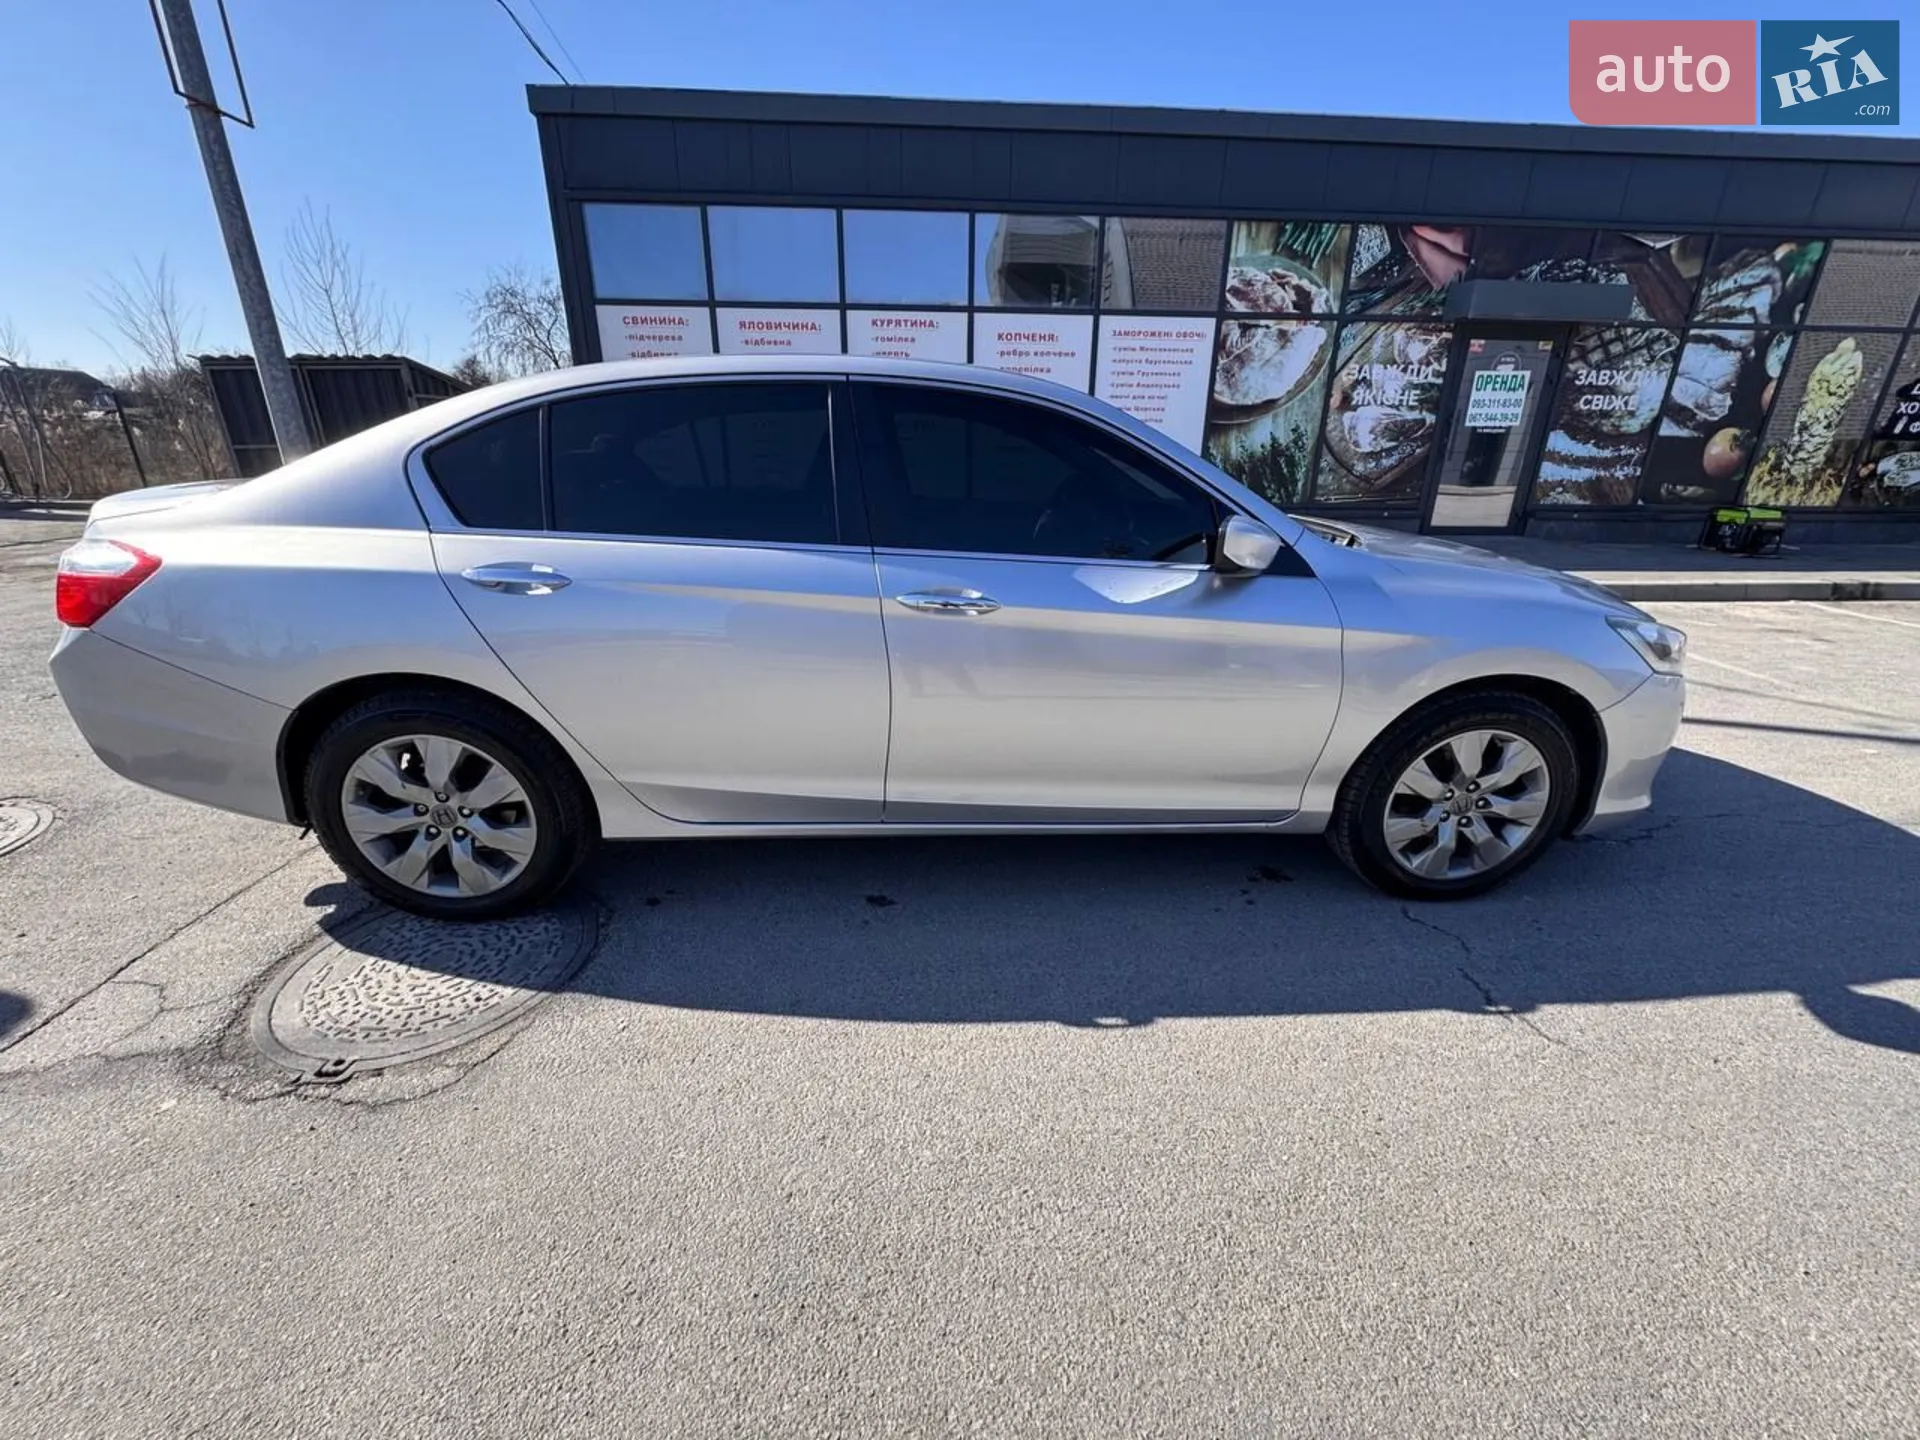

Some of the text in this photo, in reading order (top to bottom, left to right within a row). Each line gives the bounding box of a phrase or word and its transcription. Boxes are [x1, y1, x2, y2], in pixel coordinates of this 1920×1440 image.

[622, 315, 689, 326] СВИНИНА:
[738, 320, 822, 332] ЯЛОВИЧИНА:
[870, 318, 939, 329] КУРЯТИНА:
[997, 332, 1059, 342] КОПЧЕНЯ:
[1112, 329, 1172, 338] ЗАМОРОЖЕНІ
[1349, 363, 1434, 383] ЗАВЖДИ
[1574, 369, 1668, 387] ЗАВЖДИ
[1475, 374, 1526, 393] ОРЕНДА
[1350, 390, 1420, 406] ЯКІСНЕ
[1579, 395, 1638, 411] СВІЖЕ
